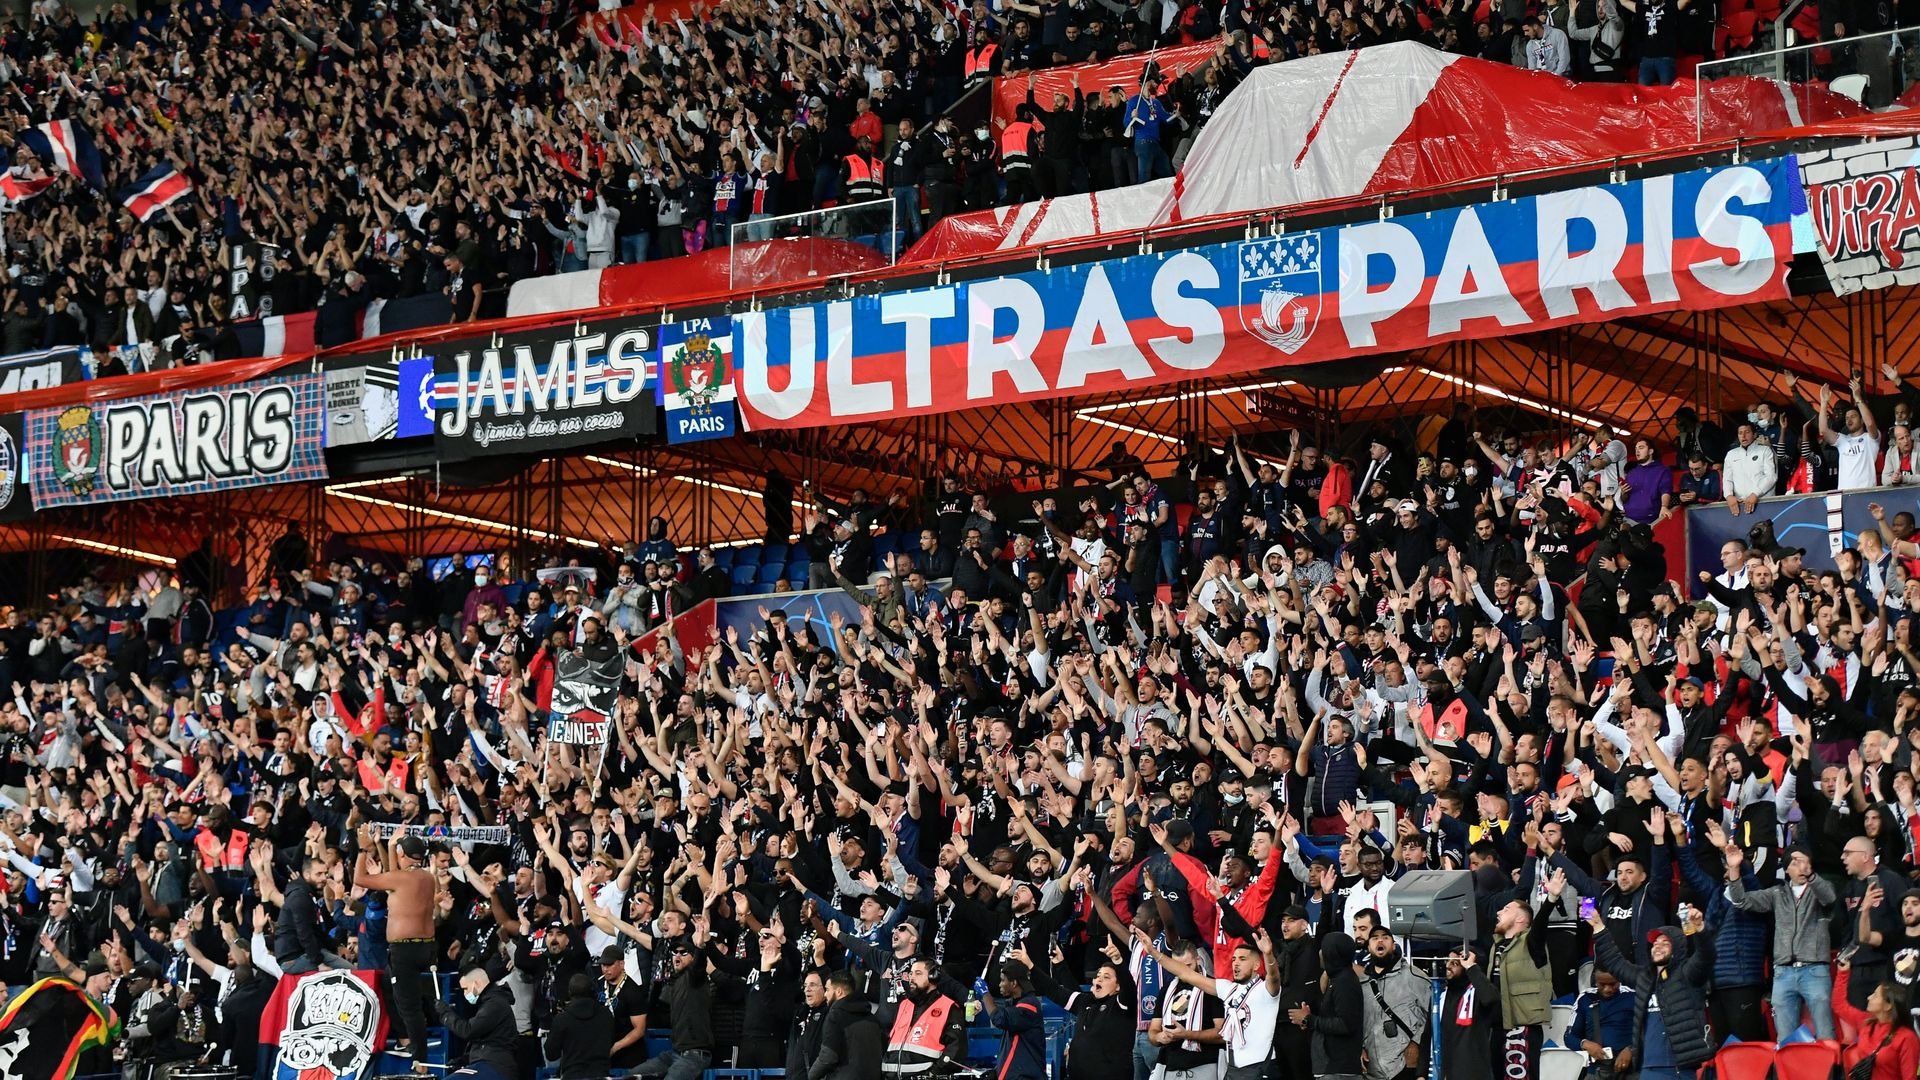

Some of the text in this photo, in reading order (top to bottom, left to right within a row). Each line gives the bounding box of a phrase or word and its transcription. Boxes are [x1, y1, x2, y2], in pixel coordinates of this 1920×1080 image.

[744, 167, 1777, 424] ULTRAS PARIS
[683, 317, 712, 335] LPA
[326, 376, 361, 393] LIBERTÉ
[441, 329, 650, 437] JAMES
[327, 396, 361, 410] ABONNÉS
[481, 420, 527, 448] jamais
[527, 415, 557, 437] dans
[558, 417, 583, 435] nos
[679, 415, 725, 435] PARIS
[105, 384, 296, 493] PARIS
[201, 692, 223, 706] 10
[548, 720, 605, 745] JEUNES
